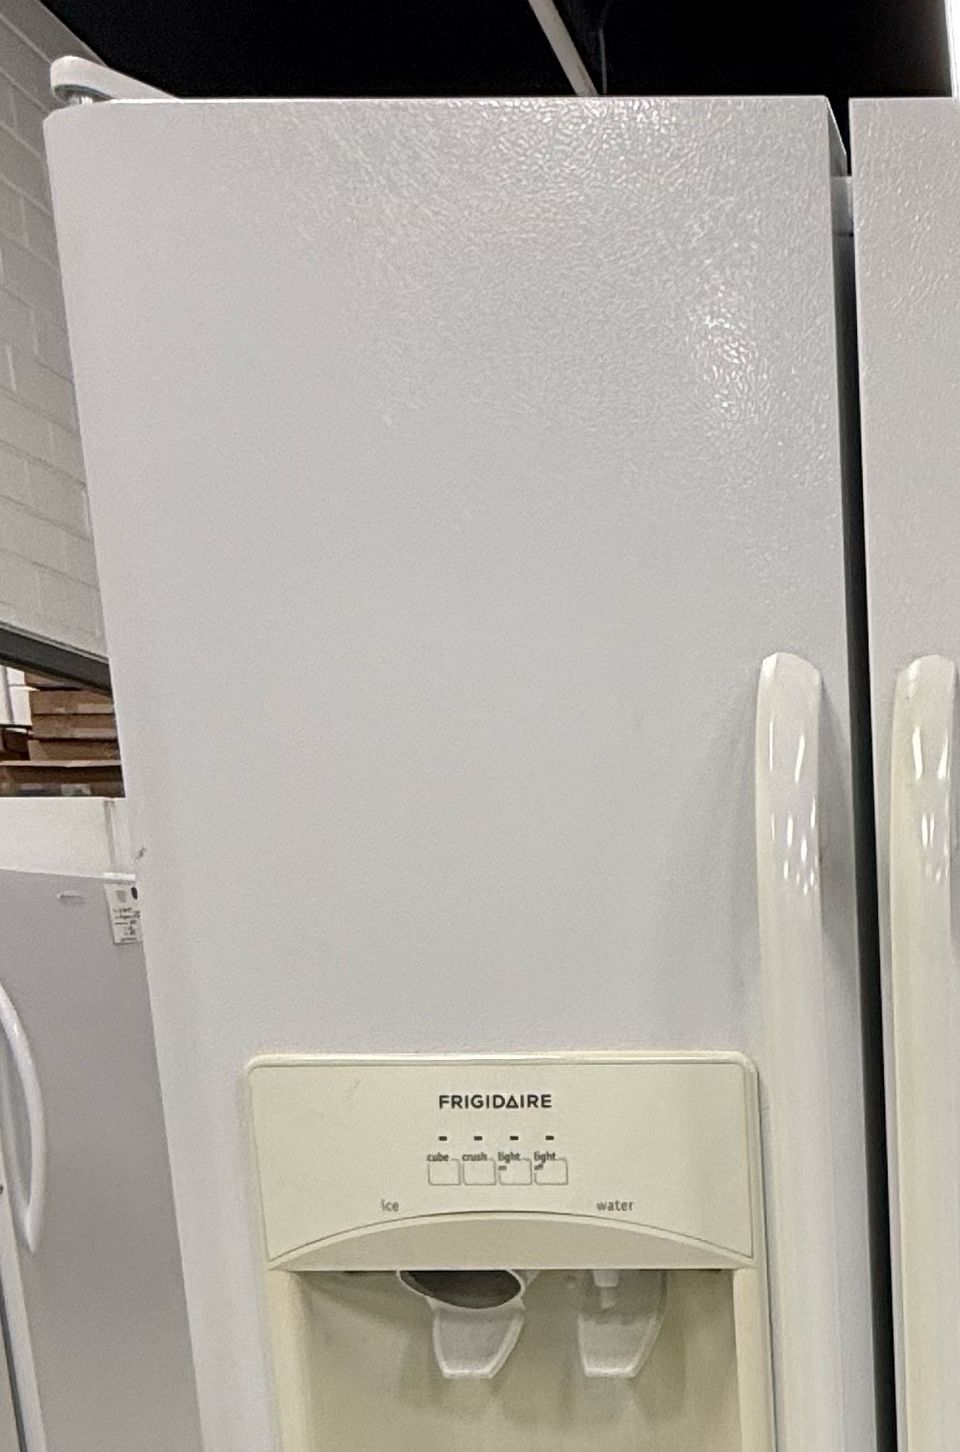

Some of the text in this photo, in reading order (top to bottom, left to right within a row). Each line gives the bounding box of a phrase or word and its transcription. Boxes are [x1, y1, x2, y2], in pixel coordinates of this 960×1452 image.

[438, 1093, 552, 1110] FRIGIDAIRE
[426, 1150, 557, 1165] cube crush light light
[596, 1199, 634, 1212] water
